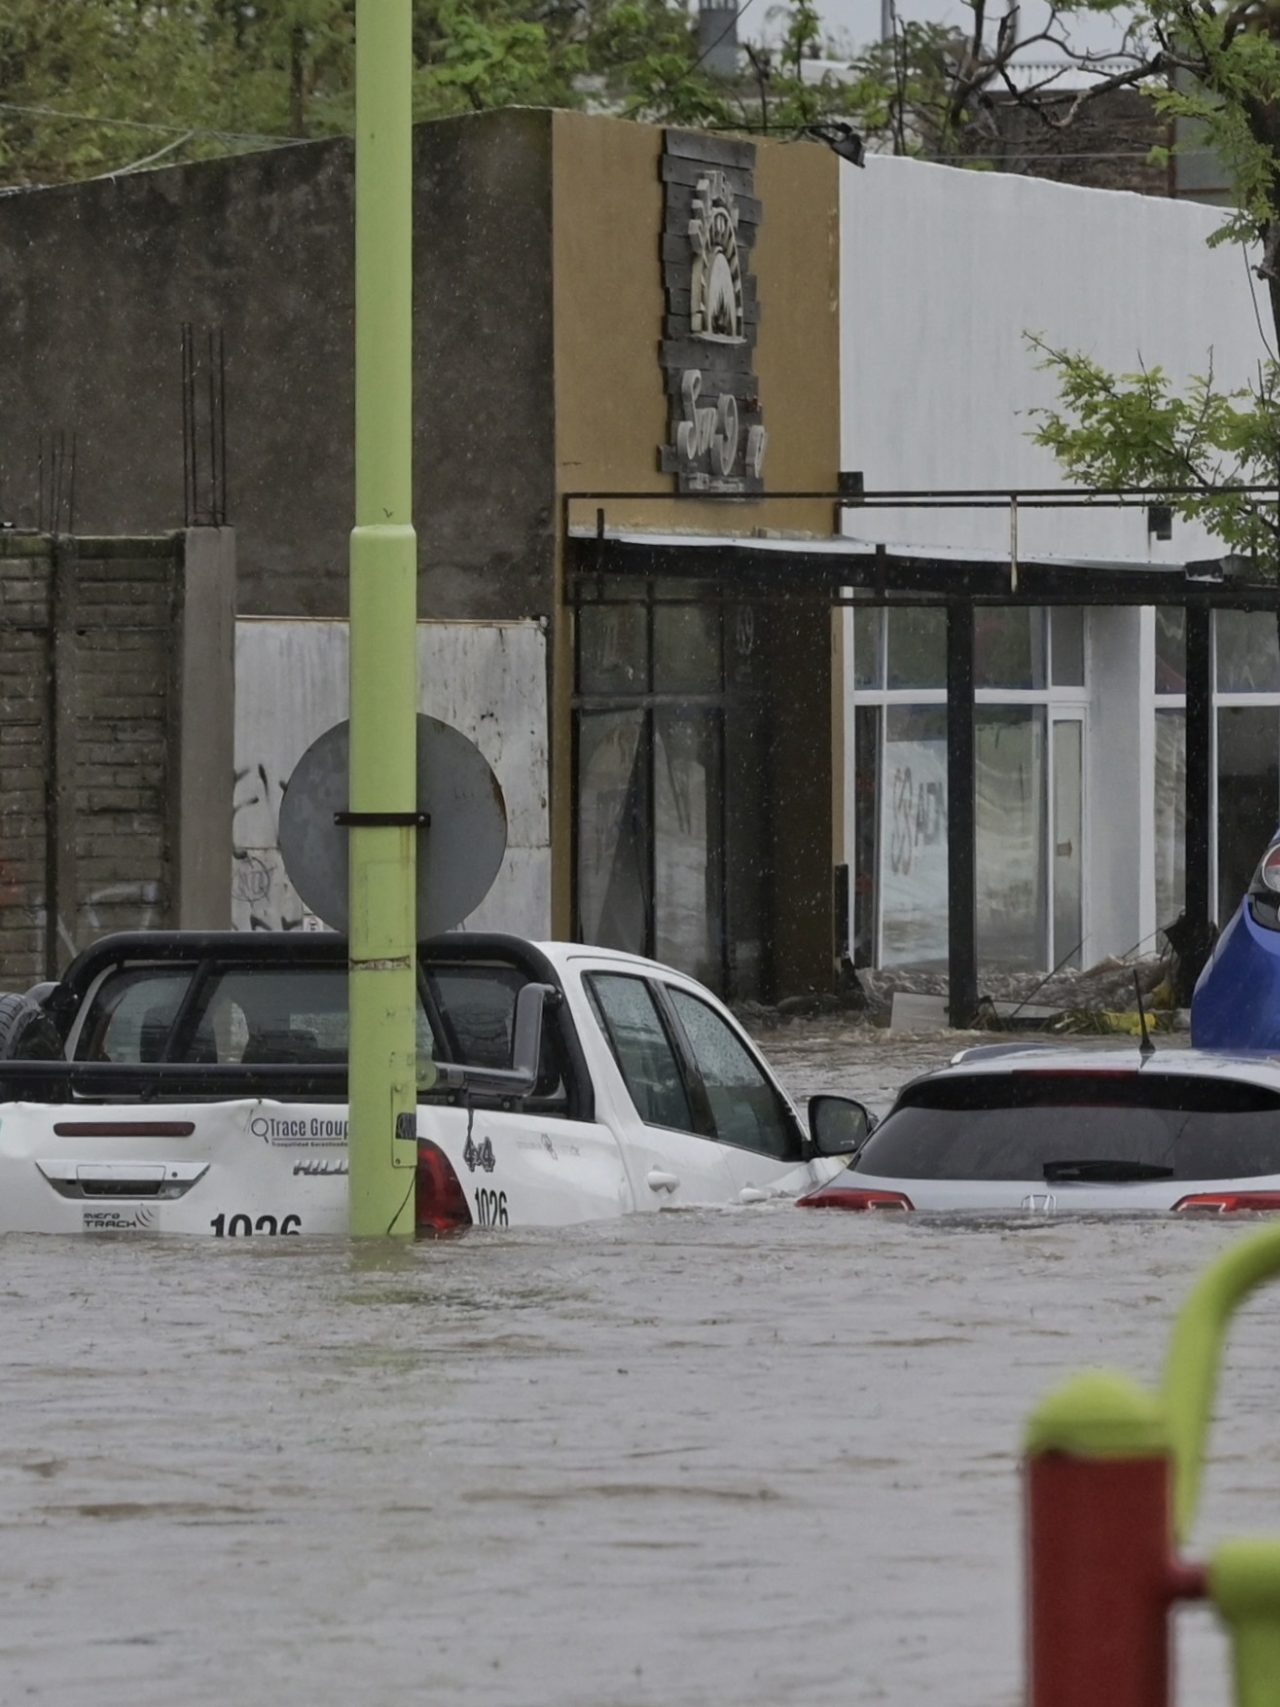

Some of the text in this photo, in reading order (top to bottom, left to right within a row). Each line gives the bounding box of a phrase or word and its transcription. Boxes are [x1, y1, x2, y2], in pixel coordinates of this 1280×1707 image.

[270, 1118, 306, 1136] Trace
[475, 1187, 509, 1226] 1026
[83, 1220, 137, 1228] TRACK
[210, 1213, 302, 1237] 1026
